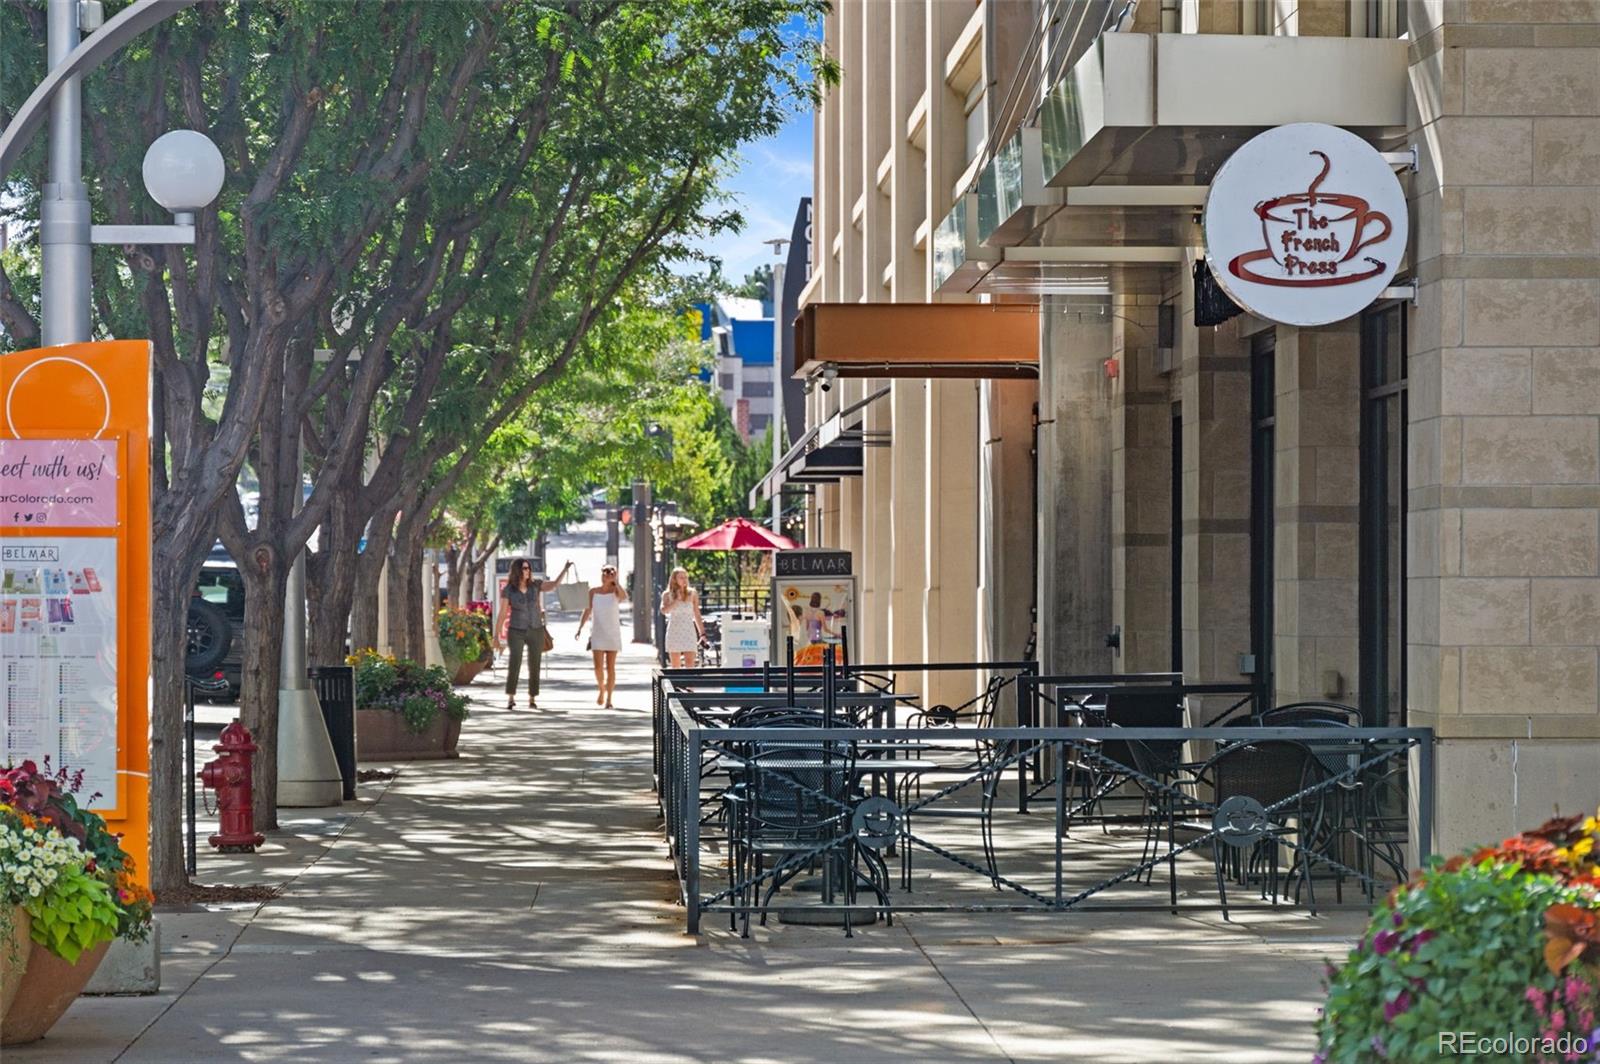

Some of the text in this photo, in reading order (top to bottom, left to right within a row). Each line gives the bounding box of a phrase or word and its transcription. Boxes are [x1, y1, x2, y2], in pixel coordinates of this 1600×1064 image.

[1293, 208, 1329, 230] The
[1283, 253, 1338, 276] Press
[32, 455, 71, 480] with
[76, 454, 106, 481] us!
[5, 548, 57, 561] BELMAR
[779, 556, 849, 573] BELMAR
